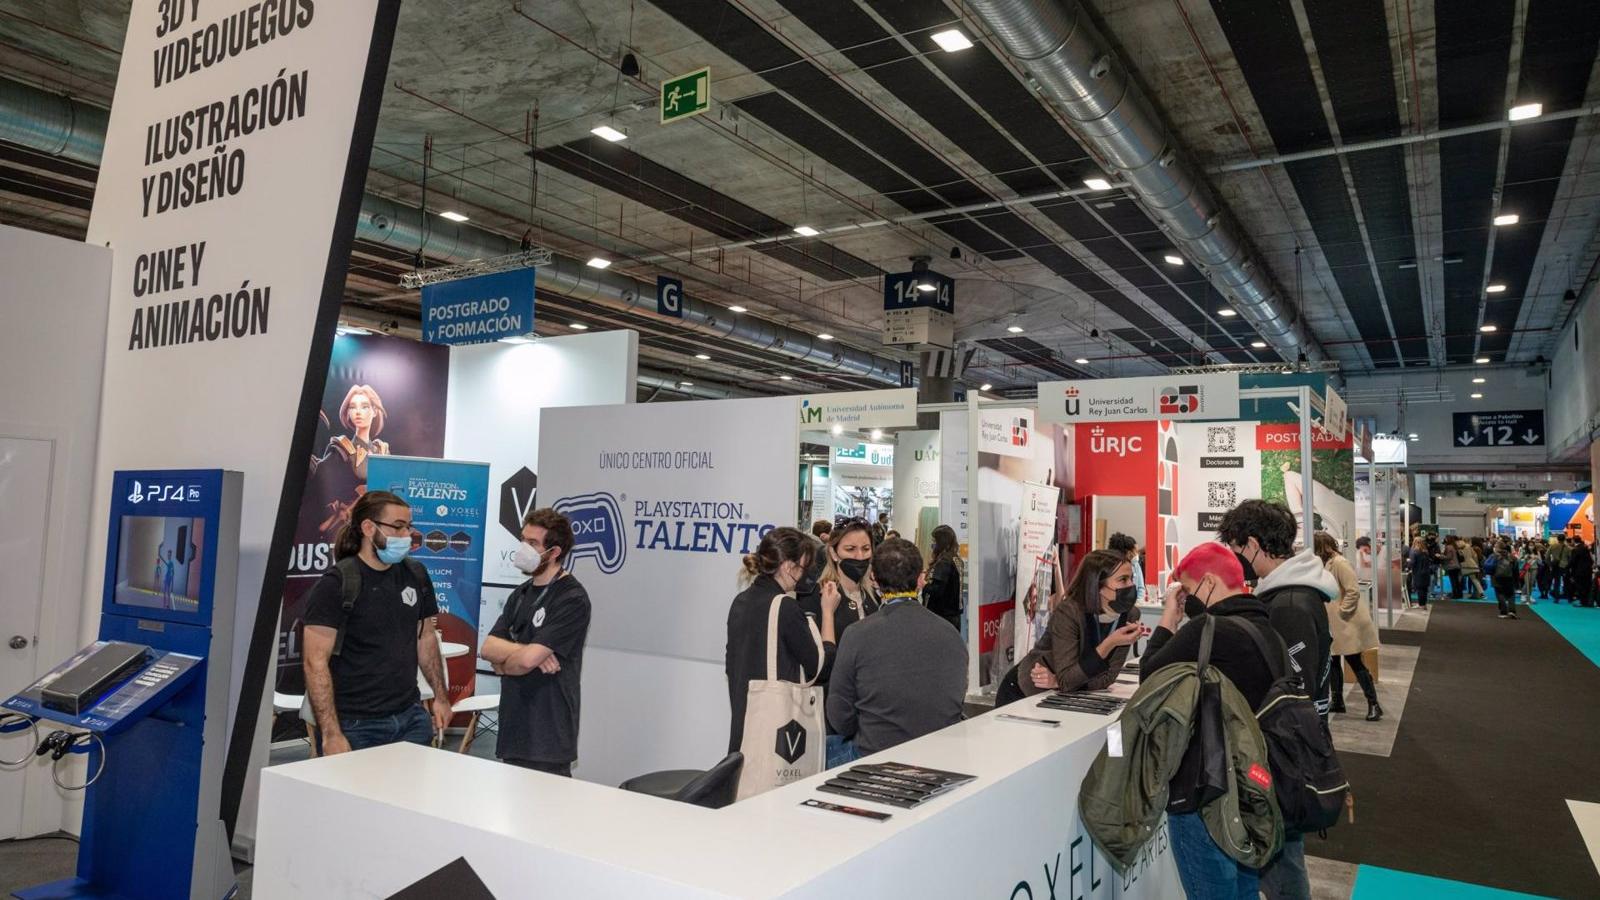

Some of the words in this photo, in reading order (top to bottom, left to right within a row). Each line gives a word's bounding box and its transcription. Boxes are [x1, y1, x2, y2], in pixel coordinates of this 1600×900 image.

[156, 0, 184, 38] 3D
[153, 0, 314, 88] VIDEOJUEGOS
[144, 68, 308, 166] ILUSTRACIÓN
[142, 177, 156, 217] Y
[157, 144, 245, 214] DISEÑO
[133, 243, 187, 297] CINE
[190, 241, 206, 286] Y
[662, 284, 678, 312] G
[894, 280, 919, 304] 14
[935, 281, 950, 307] 14
[128, 280, 270, 350] ANIMACIÓN
[428, 296, 510, 321] POSTGRADO
[428, 331, 435, 340] y
[438, 314, 522, 339] FORMACIÓN
[903, 364, 911, 384] H
[1089, 397, 1134, 406] Universidad
[1089, 408, 1103, 417] Rey
[1105, 408, 1122, 416] Juan
[1123, 406, 1148, 415] Carlos
[1482, 426, 1514, 446] 12
[600, 449, 629, 469] ÚNICO
[632, 450, 671, 469] CENTRO
[675, 450, 714, 469] OFICIAL
[1205, 458, 1240, 467] Doctorados
[147, 485, 184, 501] PS4
[408, 486, 468, 500] TALENTS
[450, 507, 480, 516] VOXEL
[635, 500, 743, 519] PLAYSTATION
